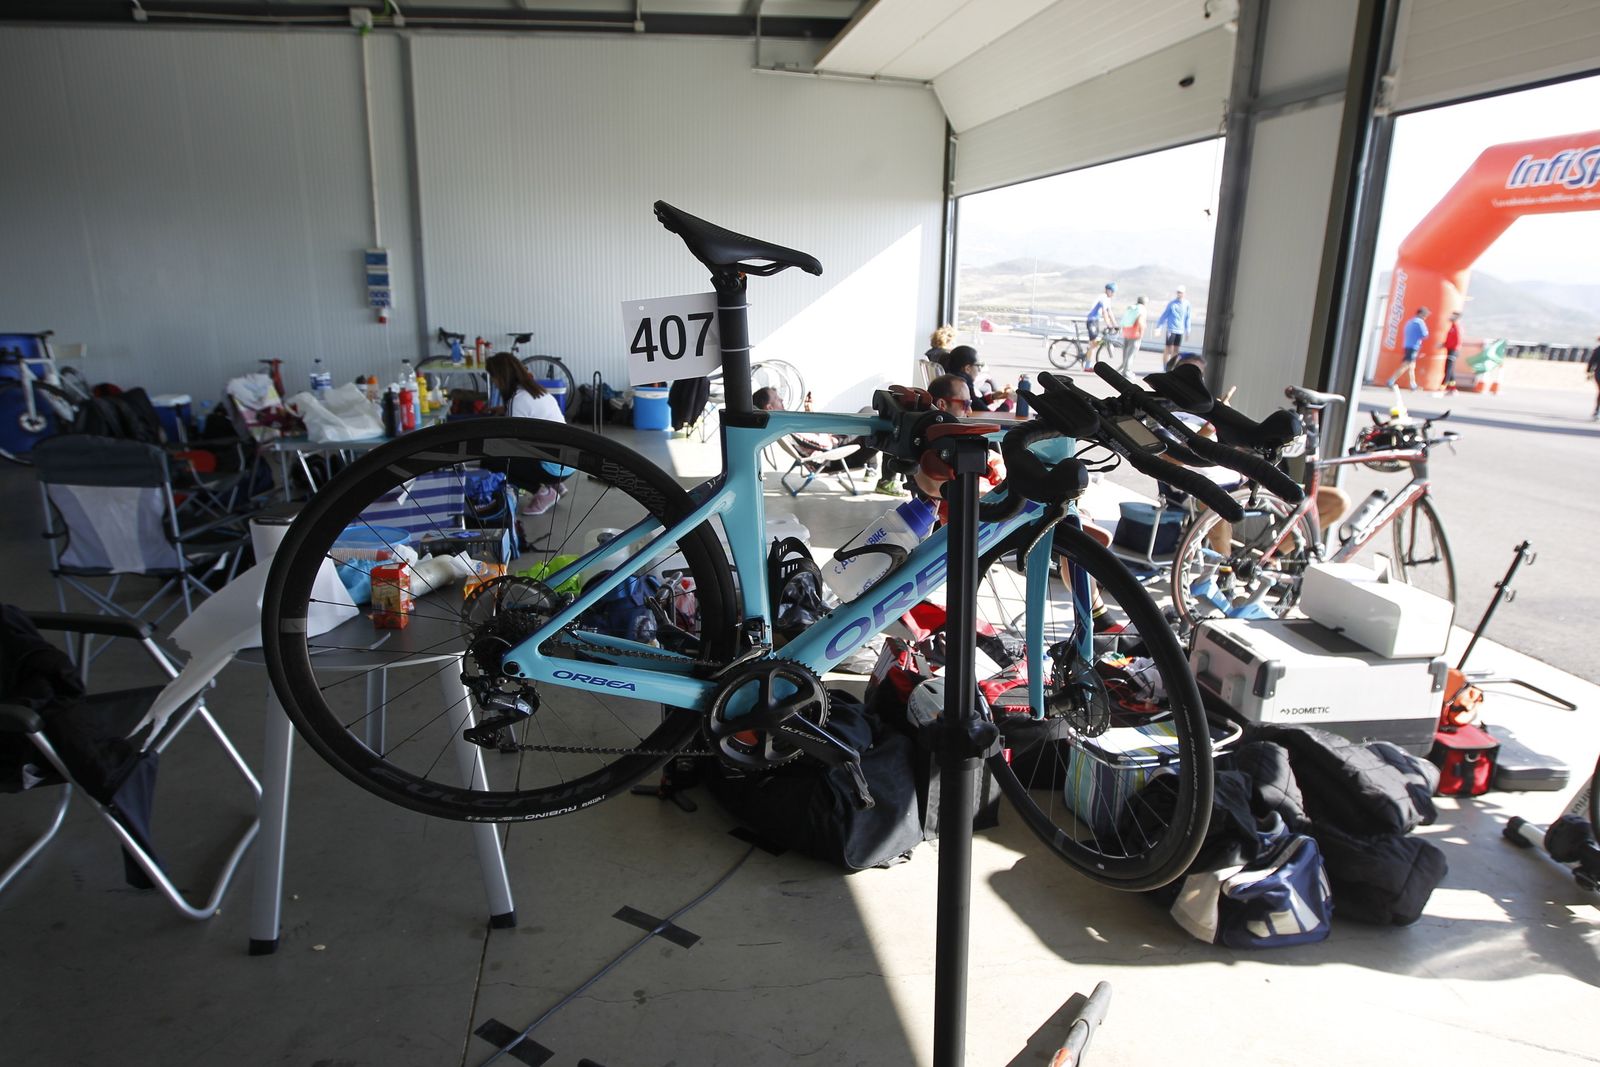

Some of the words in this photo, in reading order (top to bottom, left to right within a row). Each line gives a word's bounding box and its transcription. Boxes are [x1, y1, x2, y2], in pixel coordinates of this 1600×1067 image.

[630, 312, 714, 362] 407
[552, 670, 636, 692] ORBEA
[1291, 706, 1331, 715] DOMETIC
[780, 725, 828, 744] ULTEGRA
[524, 805, 577, 821] RUBINO
